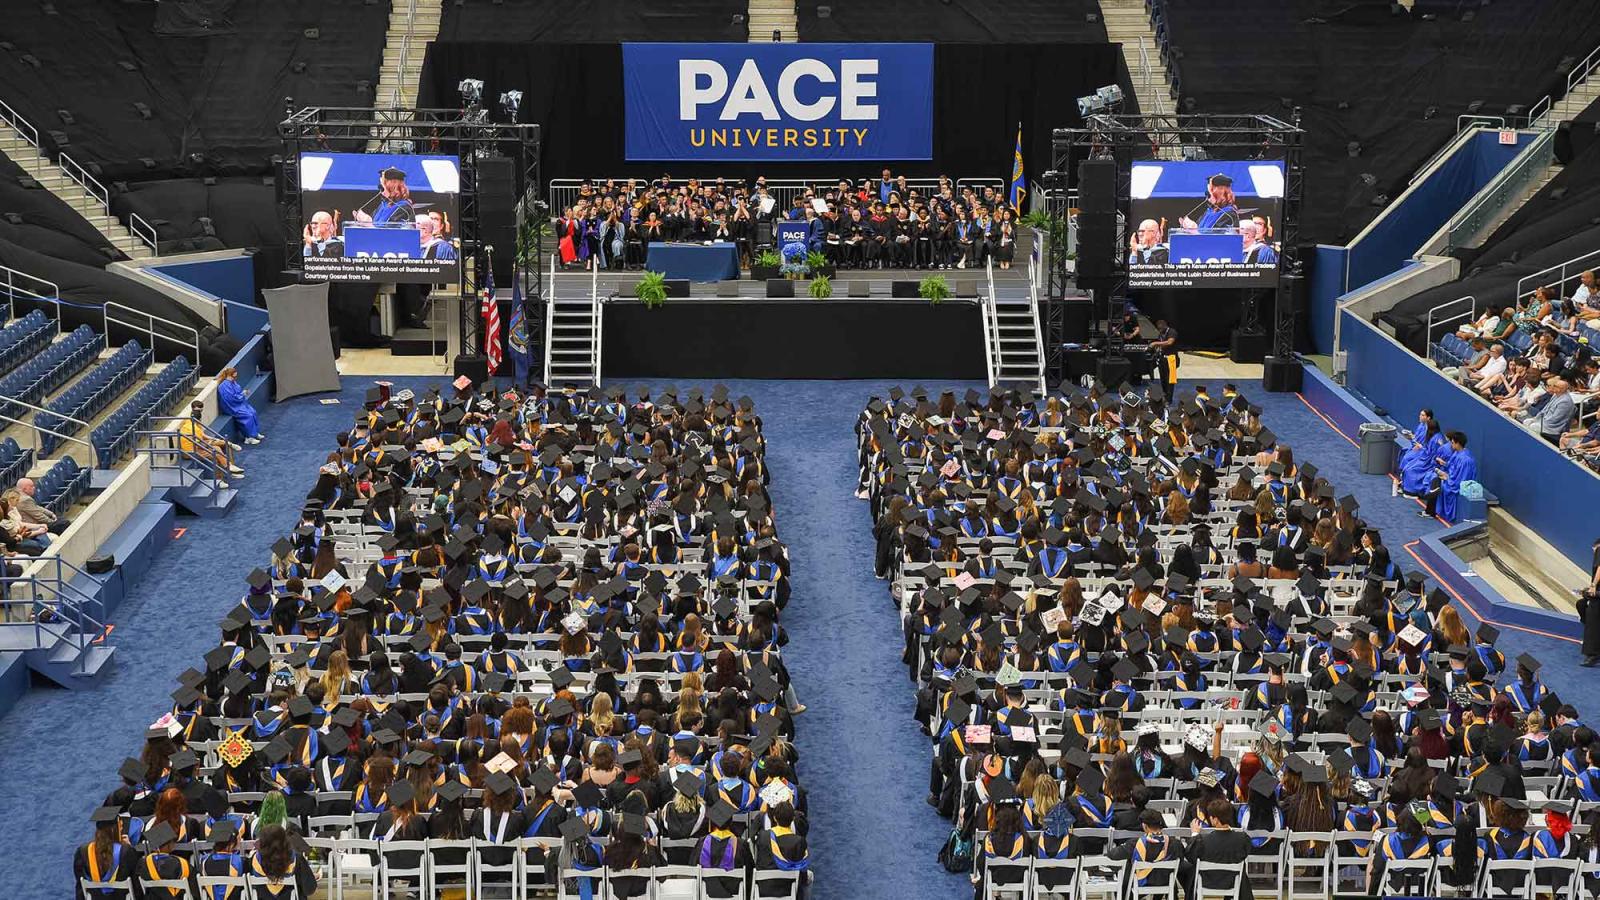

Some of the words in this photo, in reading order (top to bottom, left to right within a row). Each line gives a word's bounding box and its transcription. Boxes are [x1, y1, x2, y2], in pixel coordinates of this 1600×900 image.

[679, 58, 879, 121] PACE
[690, 128, 868, 147] UNIVERSITY
[783, 231, 805, 240] PACE
